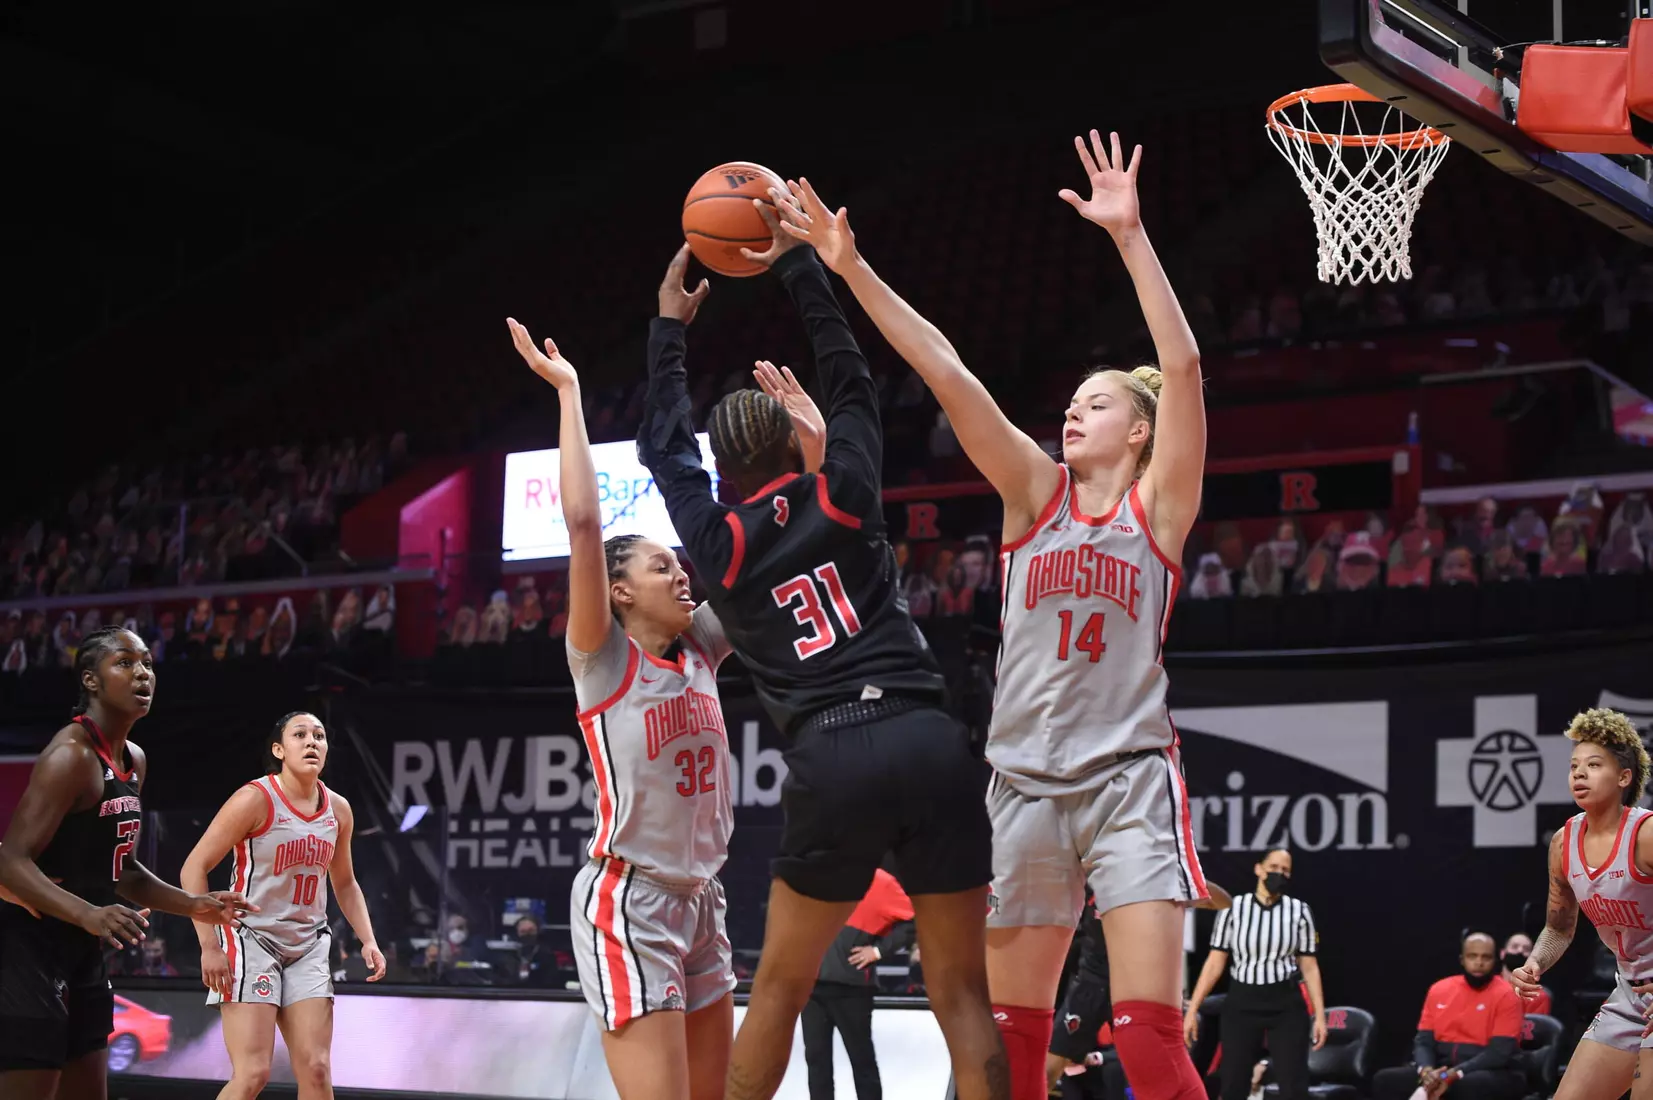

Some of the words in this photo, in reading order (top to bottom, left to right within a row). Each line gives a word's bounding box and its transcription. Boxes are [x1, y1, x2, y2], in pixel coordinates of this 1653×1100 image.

[1281, 472, 1320, 511] R
[907, 503, 940, 539] R
[771, 561, 862, 661] 31
[1057, 610, 1107, 663] 14
[674, 746, 716, 797] 32
[1189, 771, 1394, 852] rizon
[292, 873, 319, 906] 10
[1615, 930, 1631, 961] 1
[1327, 1010, 1348, 1029] R
